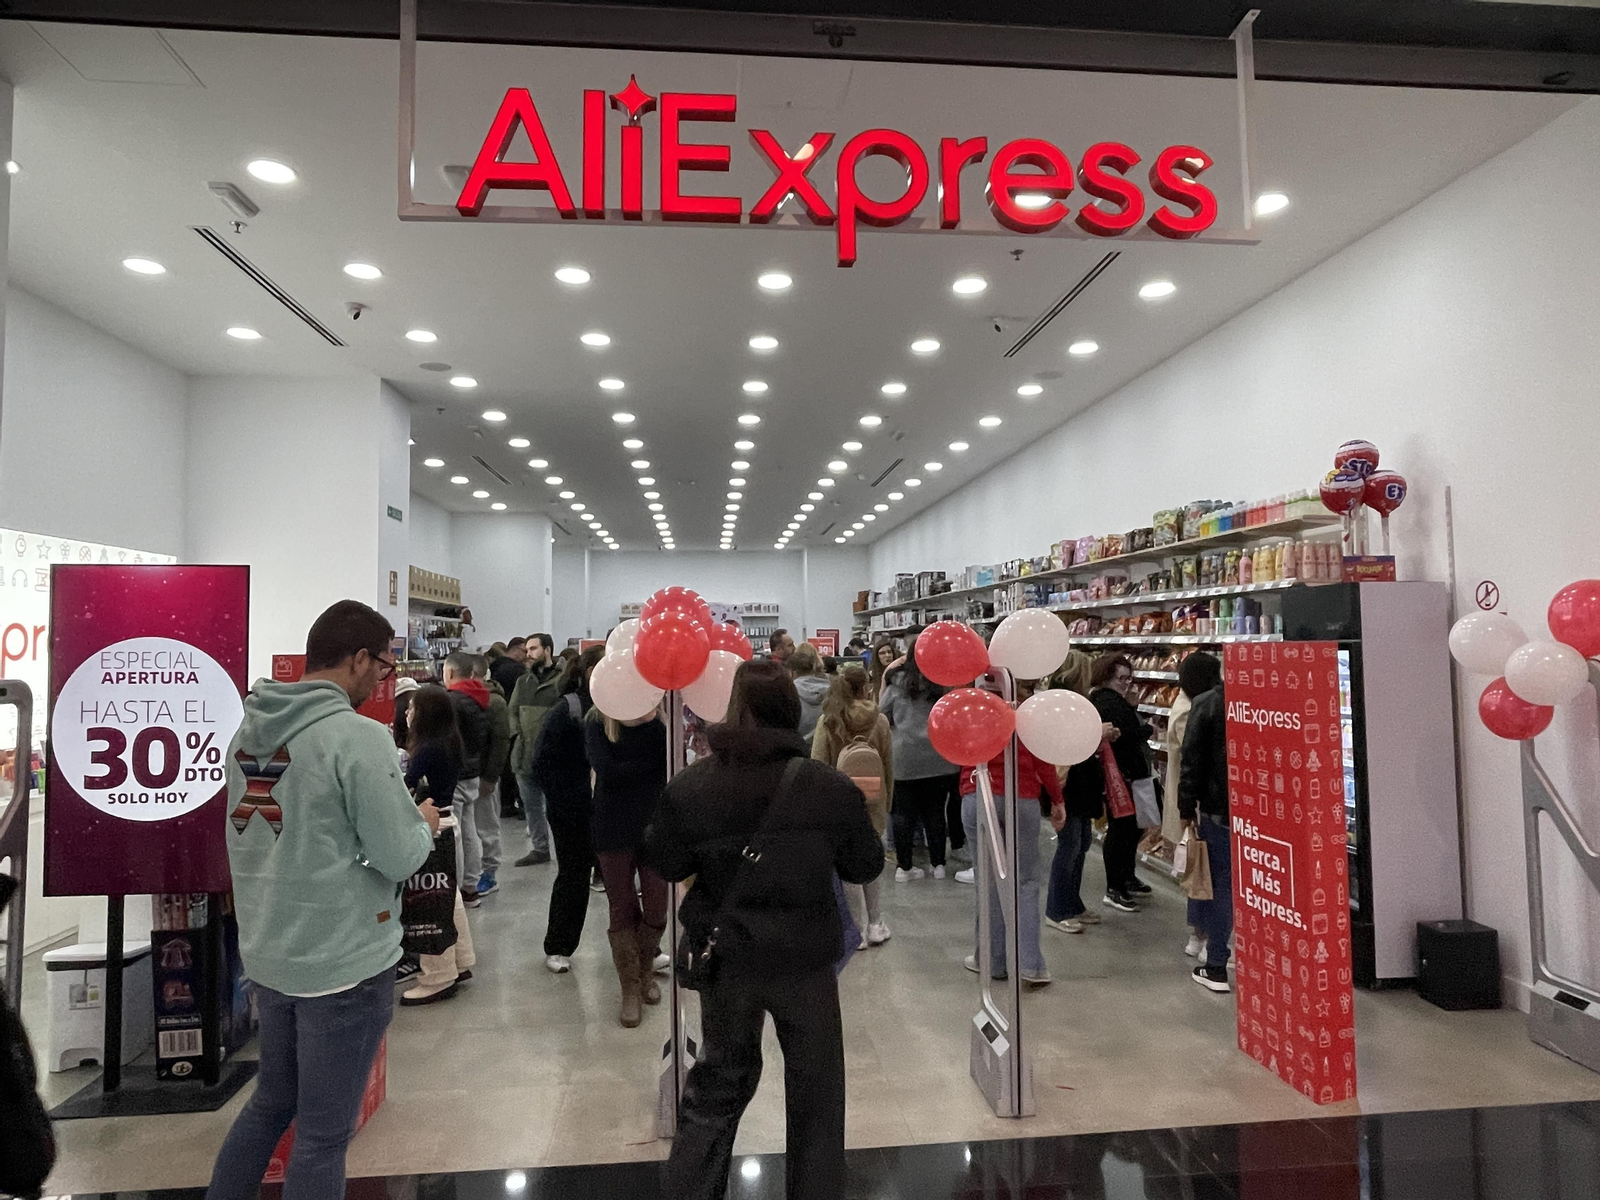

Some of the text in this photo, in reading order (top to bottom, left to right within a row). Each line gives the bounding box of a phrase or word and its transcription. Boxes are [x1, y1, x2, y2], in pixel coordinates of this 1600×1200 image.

[455, 74, 1217, 267] AliExpress
[101, 652, 200, 669] ESPECIAL
[101, 672, 199, 685] APERTURA
[80, 700, 216, 724] HASTA EL
[1227, 701, 1301, 732] AliExpress
[108, 792, 188, 804] SOLO HOY
[1233, 816, 1259, 840] Más
[1243, 845, 1285, 873] cerca.
[1252, 867, 1281, 896] Más
[1246, 887, 1307, 931] Express.
